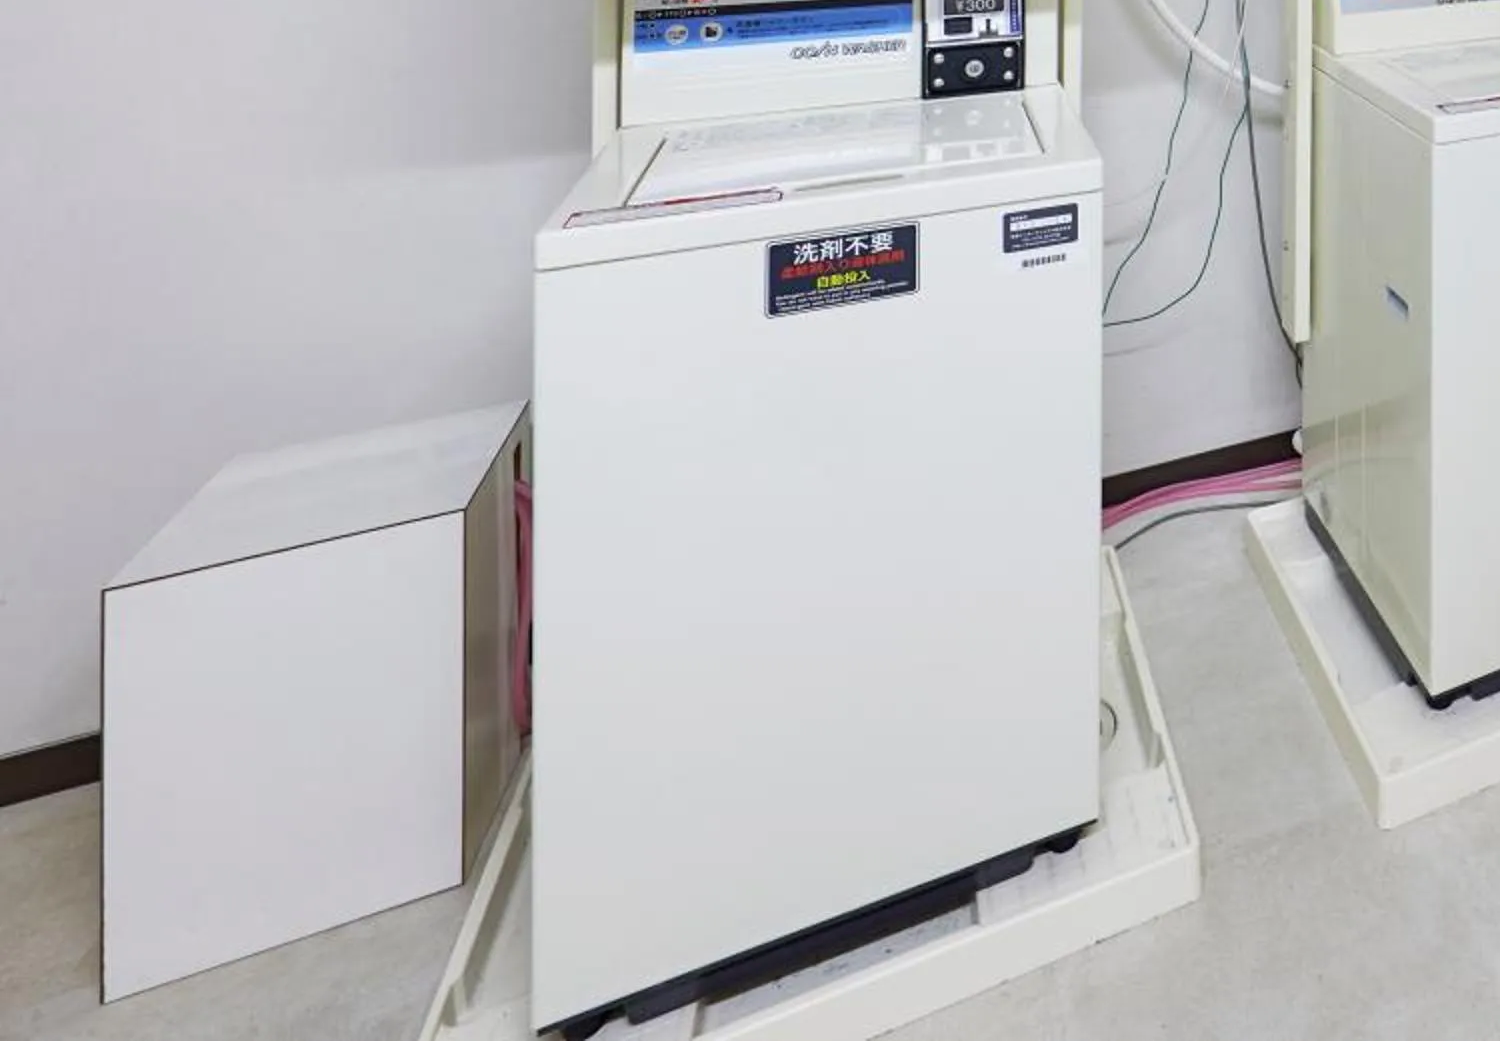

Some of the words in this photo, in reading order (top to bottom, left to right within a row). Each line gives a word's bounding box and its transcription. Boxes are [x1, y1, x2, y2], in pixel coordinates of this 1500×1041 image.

[793, 231, 894, 265] 洗剤不要
[816, 270, 872, 290] 自動投入
